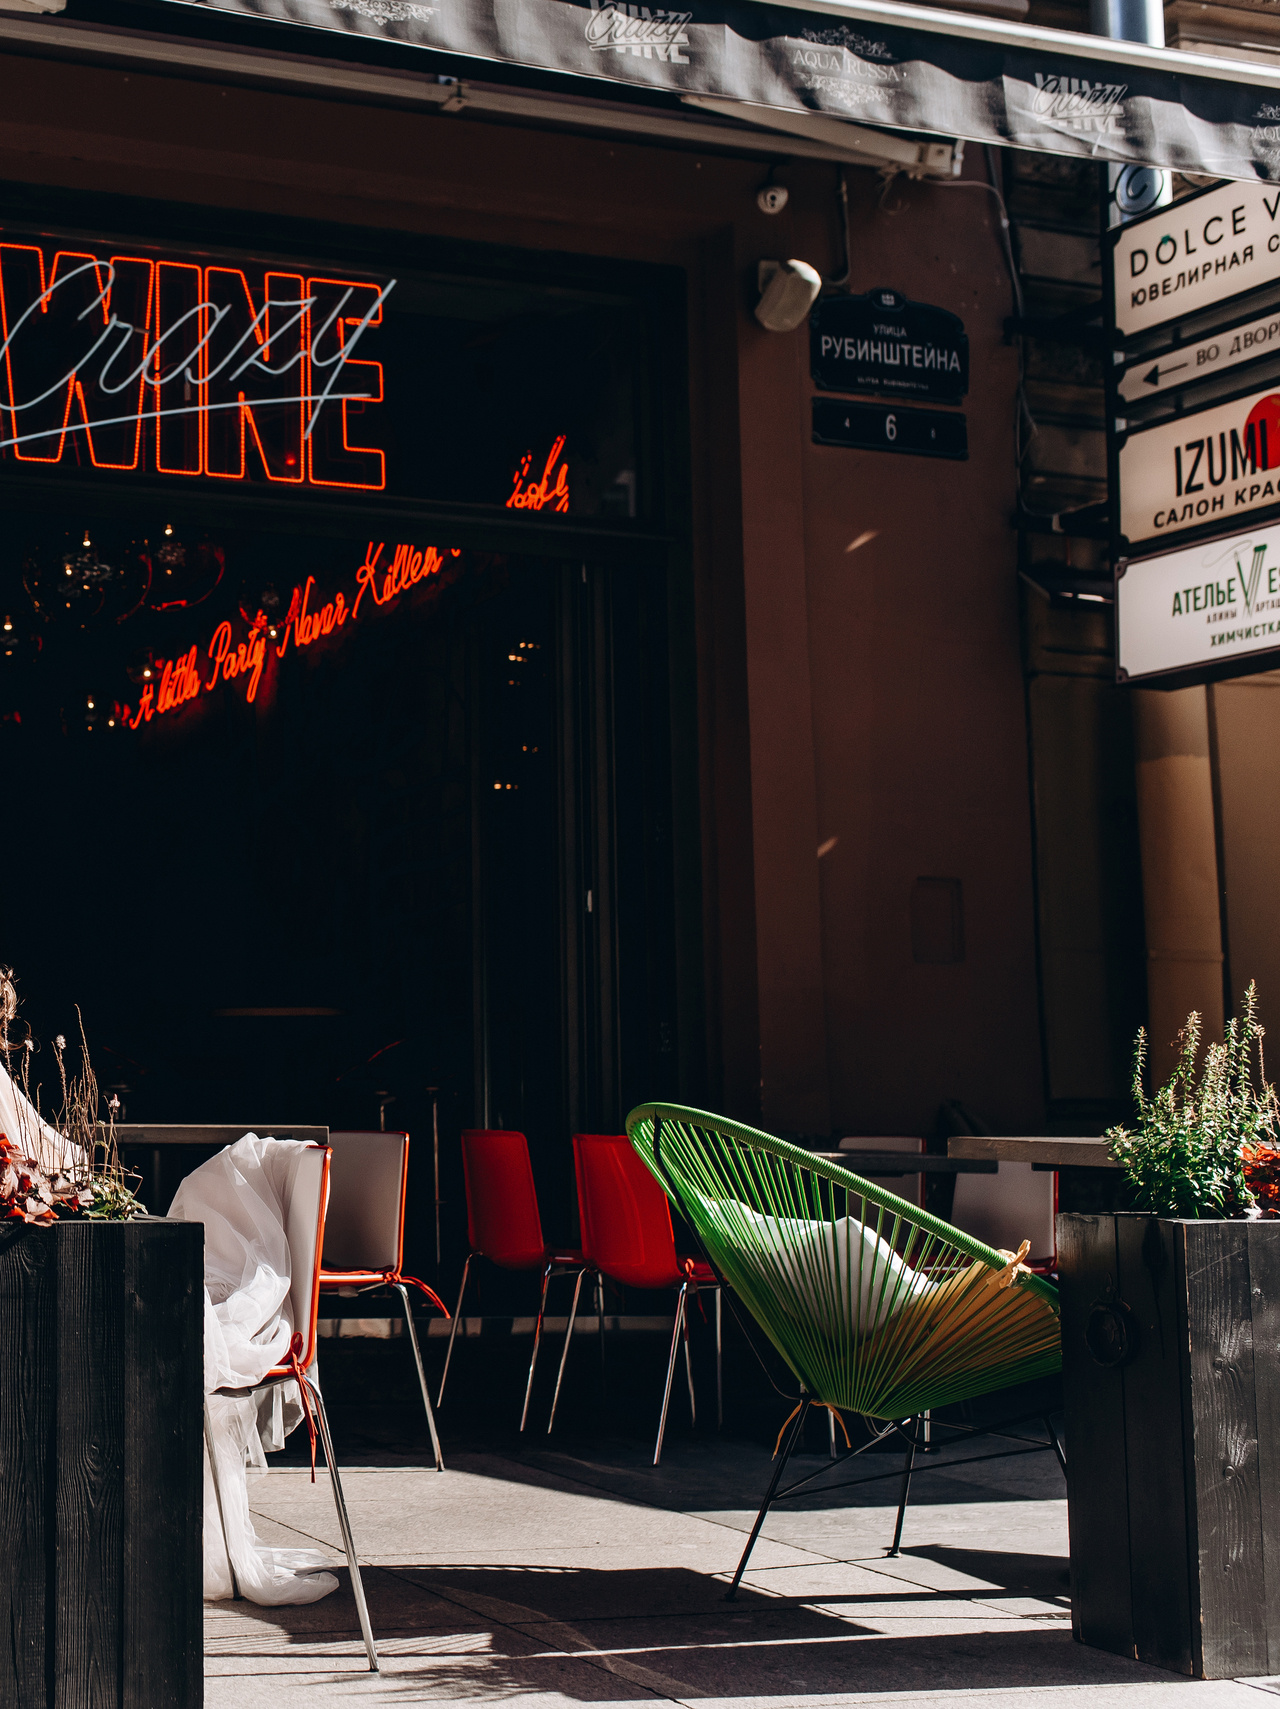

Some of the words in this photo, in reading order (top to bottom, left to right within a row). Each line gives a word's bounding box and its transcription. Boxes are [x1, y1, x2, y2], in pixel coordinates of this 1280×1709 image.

[585, 2, 693, 55] Crazy
[793, 49, 841, 72] AQUA
[847, 58, 899, 82] RUSSA
[1032, 77, 1129, 127] Crazy
[1130, 205, 1246, 278] DOLCE
[1131, 245, 1253, 308] ЮВЕЛИРНАЯ
[873, 324, 908, 337] УЛИЦА
[1195, 344, 1220, 367] ВО
[1228, 320, 1280, 357] ДВОР
[821, 335, 961, 373] РУБИНШТЕЙНА
[885, 414, 898, 441] 6
[1173, 418, 1268, 497] IZUMI
[1153, 494, 1225, 528] САЛОН
[1172, 577, 1237, 617] АТЕЛЬЕ
[1206, 608, 1237, 624] АЛИНЫ
